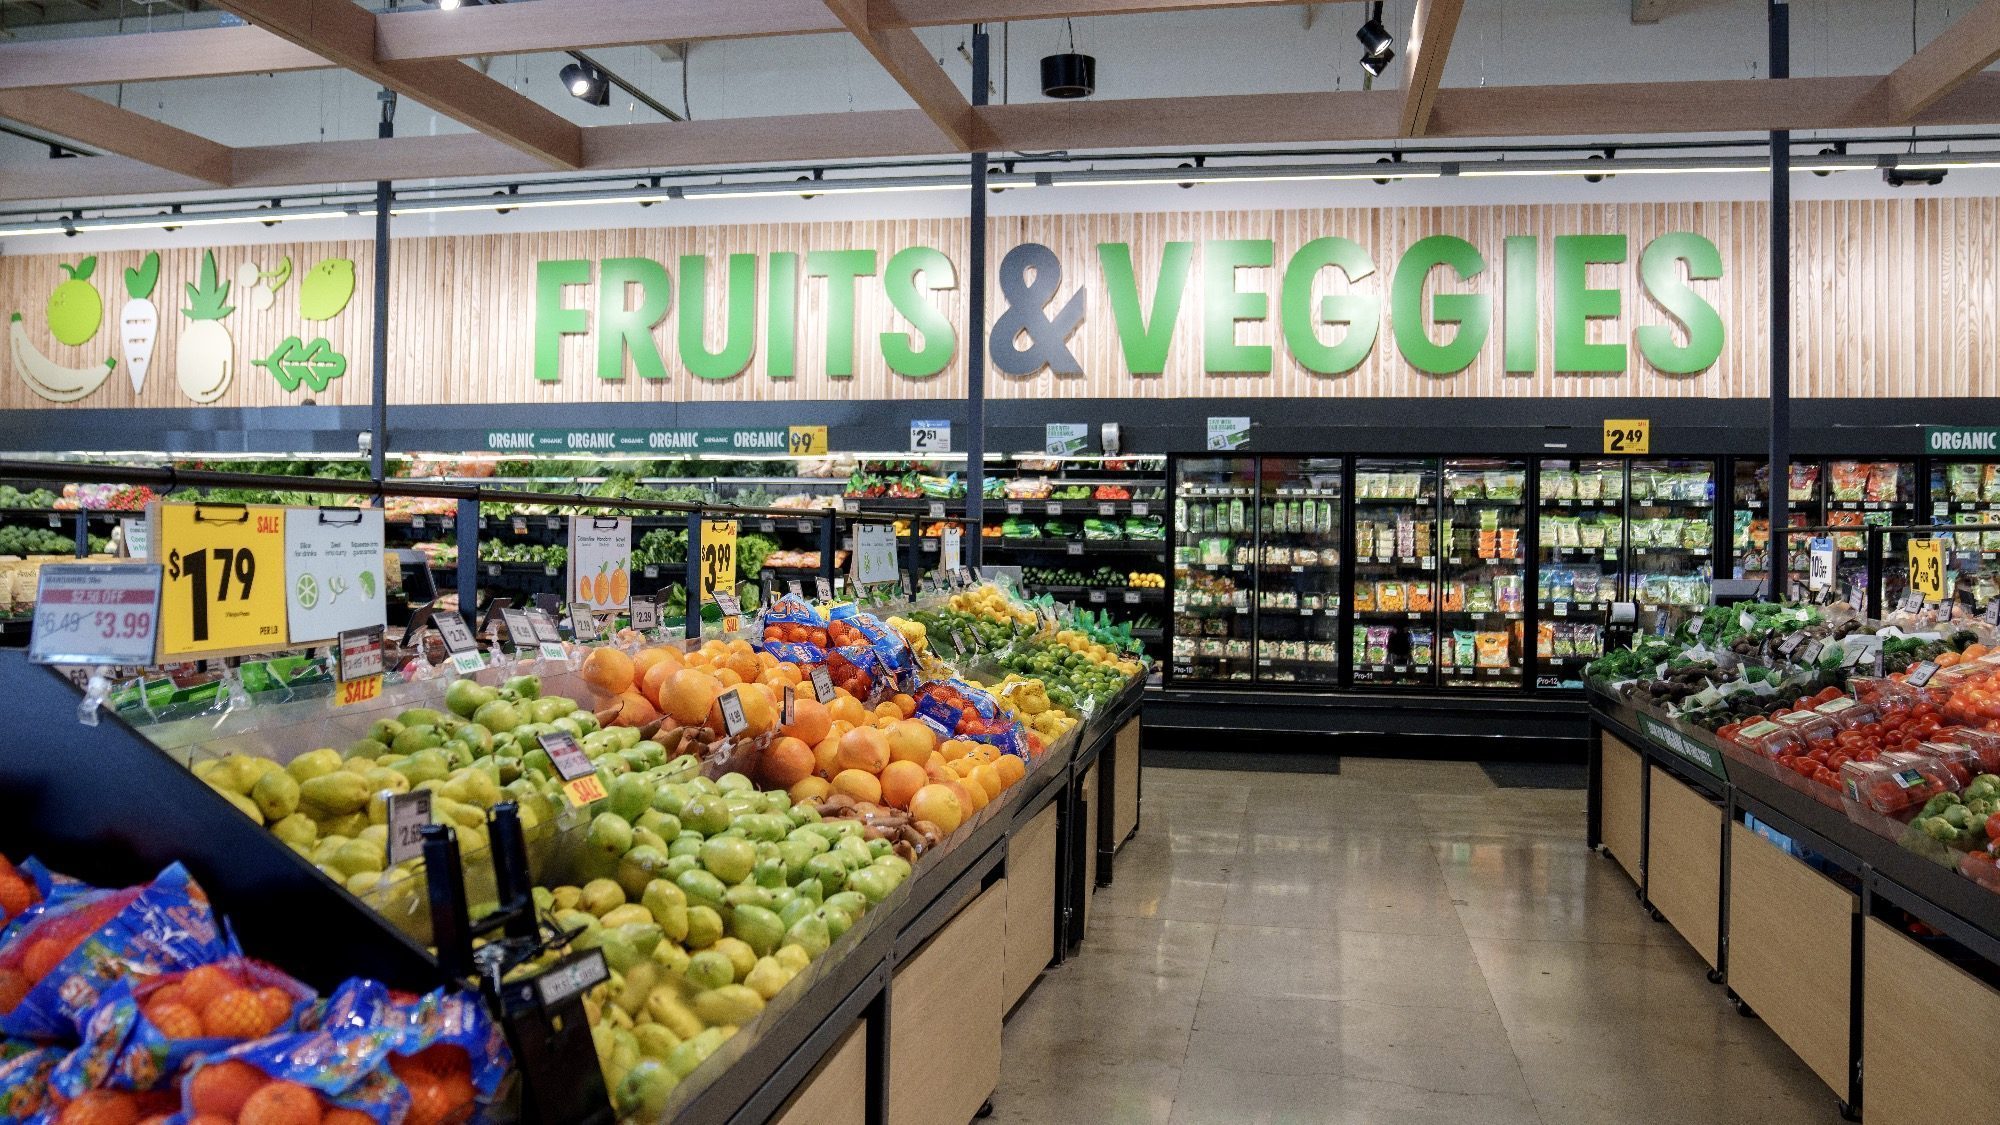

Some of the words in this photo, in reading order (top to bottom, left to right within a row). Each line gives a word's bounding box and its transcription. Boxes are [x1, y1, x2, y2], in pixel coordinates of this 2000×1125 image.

[534, 246, 958, 382] FRUITS
[987, 243, 1086, 378] &
[1096, 232, 1725, 377] VEGGIES
[488, 432, 535, 448] ORGANIC
[568, 432, 616, 448] ORGANIC
[649, 432, 699, 448] ORGANIC
[734, 432, 785, 448] ORGANIC
[1931, 431, 1997, 450] ORGANIC
[257, 516, 279, 534] SALE
[1911, 556, 1920, 590] 2
[103, 591, 125, 604] OFF
[95, 611, 150, 639] $3.99
[260, 626, 270, 635] PER
[543, 646, 565, 658] New!
[455, 654, 482, 672] New!
[1354, 672, 1373, 680] Pro-11
[1537, 677, 1558, 685] Pro-12
[344, 677, 376, 704] SALE
[572, 778, 602, 802] SALE
